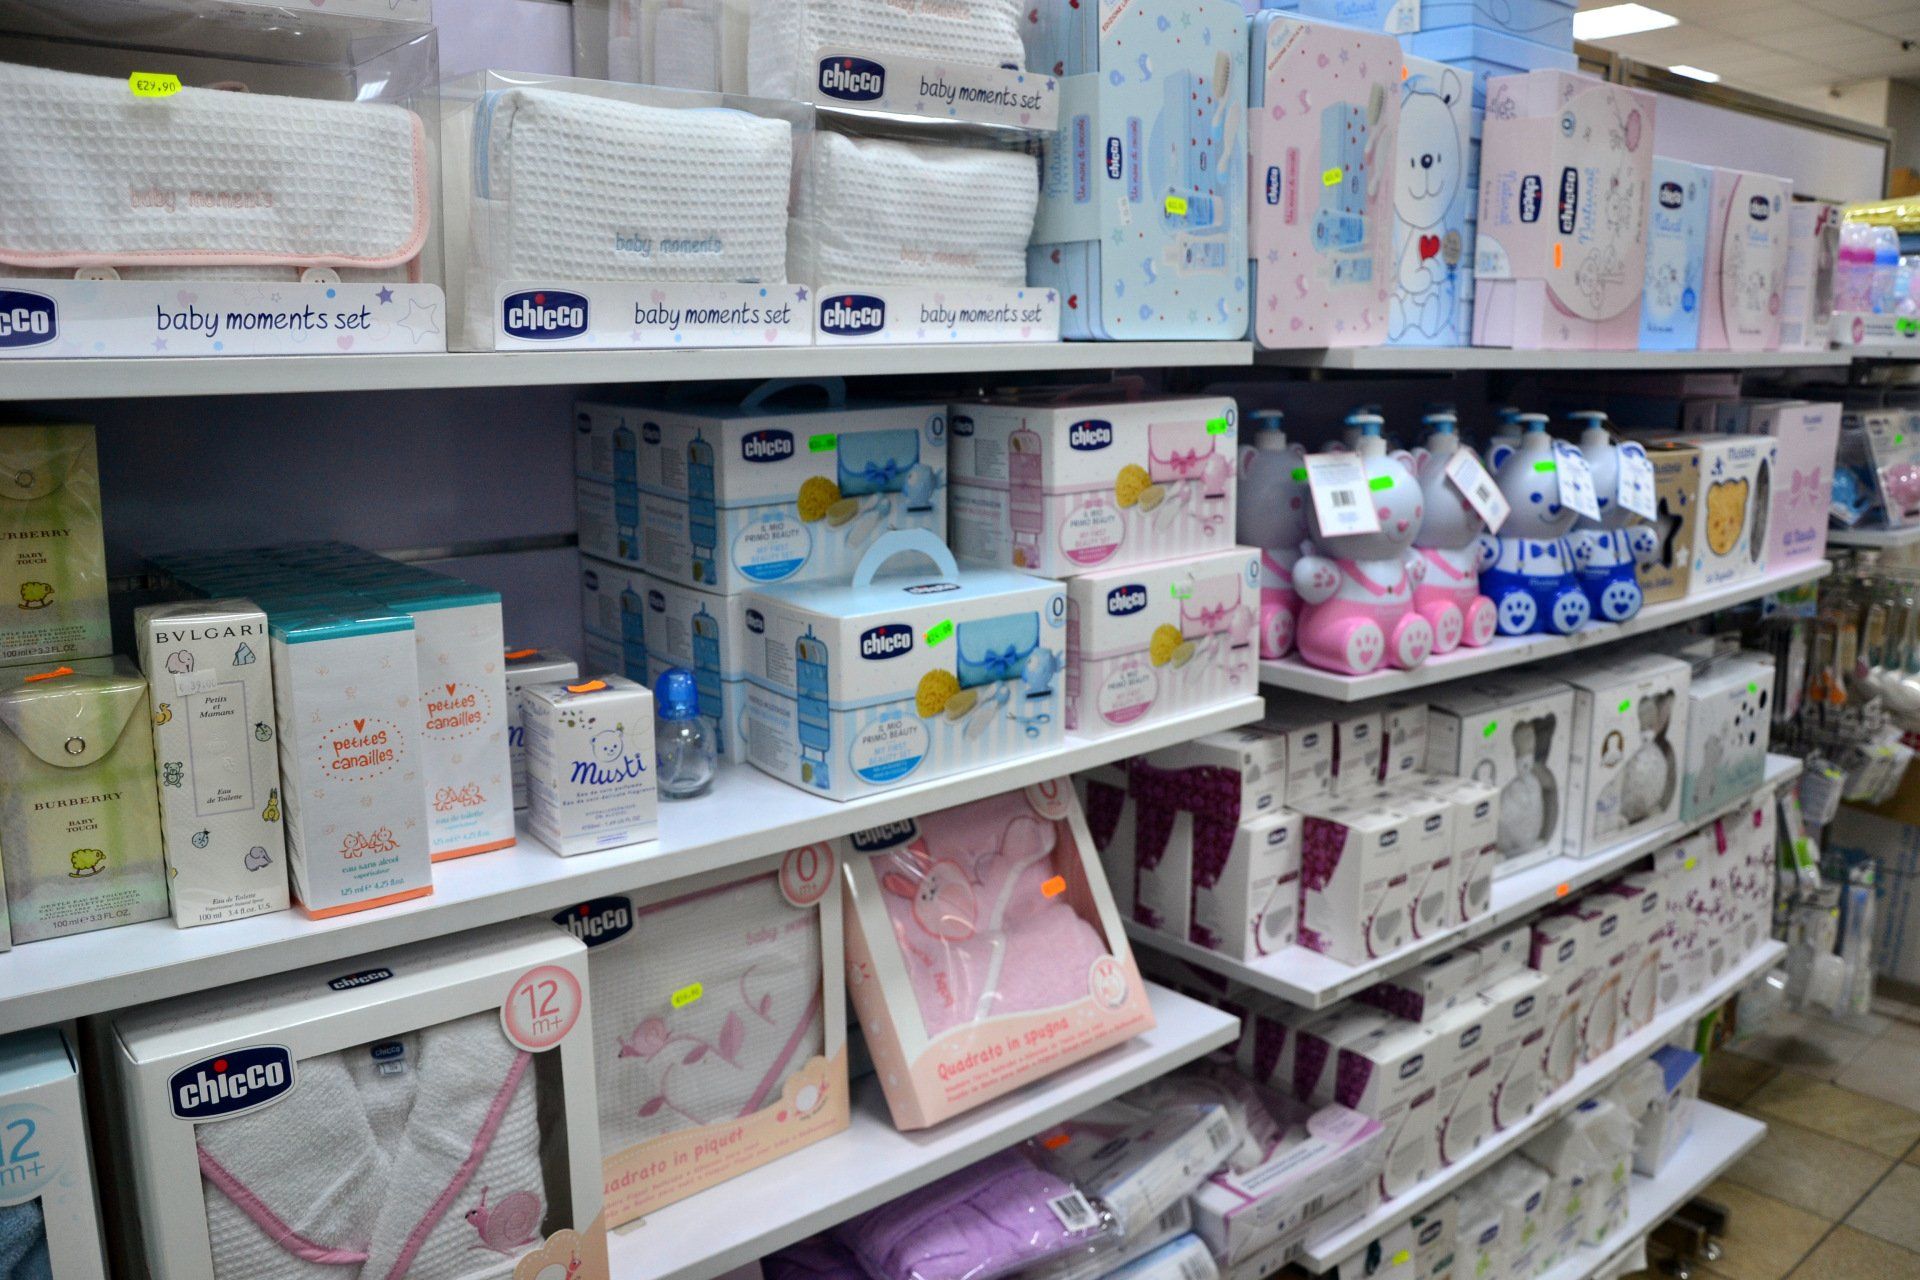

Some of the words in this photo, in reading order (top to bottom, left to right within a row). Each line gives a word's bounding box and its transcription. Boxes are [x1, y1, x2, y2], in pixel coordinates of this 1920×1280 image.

[823, 59, 881, 94] chicco
[920, 76, 955, 104] baby
[960, 84, 1018, 107] moments
[1022, 91, 1042, 110] set
[1107, 139, 1120, 177] chicco
[130, 178, 176, 213] baby
[189, 187, 277, 210] moments
[1558, 170, 1576, 232] chicco
[616, 232, 650, 258] baby
[660, 233, 723, 254] moments
[157, 305, 219, 337] baby
[226, 305, 328, 330] moments
[335, 306, 372, 330] set
[509, 294, 584, 330] chicco
[635, 302, 680, 330] baby
[685, 302, 760, 324] moments
[764, 302, 791, 324] set
[824, 297, 882, 328] chicco
[921, 304, 956, 329] baby
[960, 304, 1018, 323] moments
[1022, 304, 1042, 323] set
[932, 416, 943, 436] 0
[1072, 421, 1110, 446] chicco
[745, 431, 791, 457] chicco
[0, 529, 71, 540] RBERRY
[1251, 560, 1259, 578] 0
[1053, 597, 1064, 617] 0
[1109, 587, 1146, 612] chicco
[156, 624, 263, 644] BVLGARI
[863, 627, 911, 655] chicco
[205, 696, 227, 704] Petits
[427, 693, 476, 716] petites
[200, 709, 235, 718] Mamans
[426, 711, 481, 731] canailles
[887, 721, 902, 730] MIO
[333, 730, 387, 757] petites
[862, 733, 887, 744] PRIMO
[890, 726, 918, 738] BEAUTY
[331, 748, 394, 770] canailles
[34, 791, 123, 811] BURBERRY
[206, 797, 216, 805] de
[217, 793, 243, 802] Toilette
[217, 788, 232, 796] Eau
[66, 824, 98, 833] TOUCH
[68, 818, 95, 827] BABY
[796, 844, 818, 882] 0
[234, 893, 256, 901] Toilette
[53, 920, 68, 928] 100
[333, 970, 389, 990] chicco
[521, 979, 560, 1020] 12
[532, 1016, 564, 1036] m+
[937, 1041, 1003, 1081] Quadrato
[1006, 1037, 1020, 1049] in
[1024, 1017, 1069, 1047] spugna
[179, 1058, 284, 1110] chicco
[673, 1151, 688, 1167] in
[695, 1128, 745, 1161] piquet
